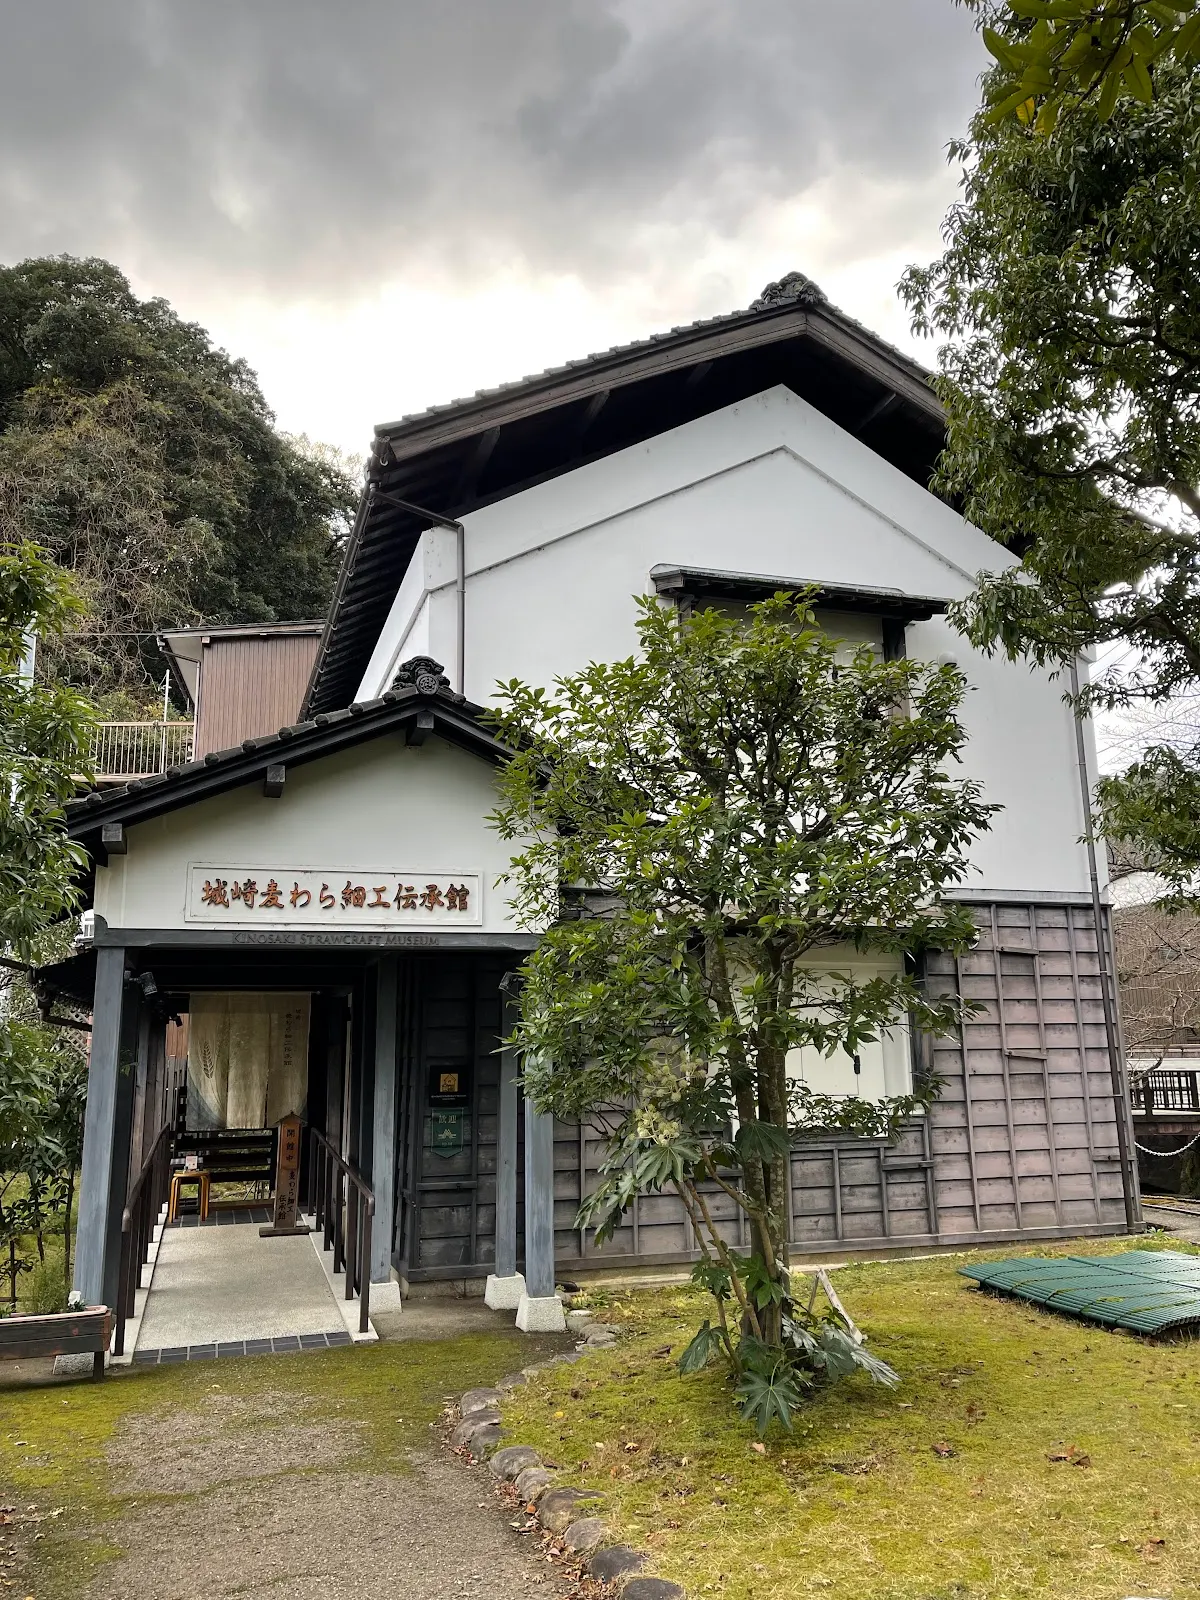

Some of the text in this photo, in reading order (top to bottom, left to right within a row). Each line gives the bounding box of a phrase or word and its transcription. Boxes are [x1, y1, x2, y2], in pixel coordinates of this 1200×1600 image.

[201, 878, 471, 912] 城崎麦わら細工伝承館
[232, 932, 440, 946] KINOSAKI STRAWCRAFT MUSEUM
[286, 1128, 296, 1163] 開館中
